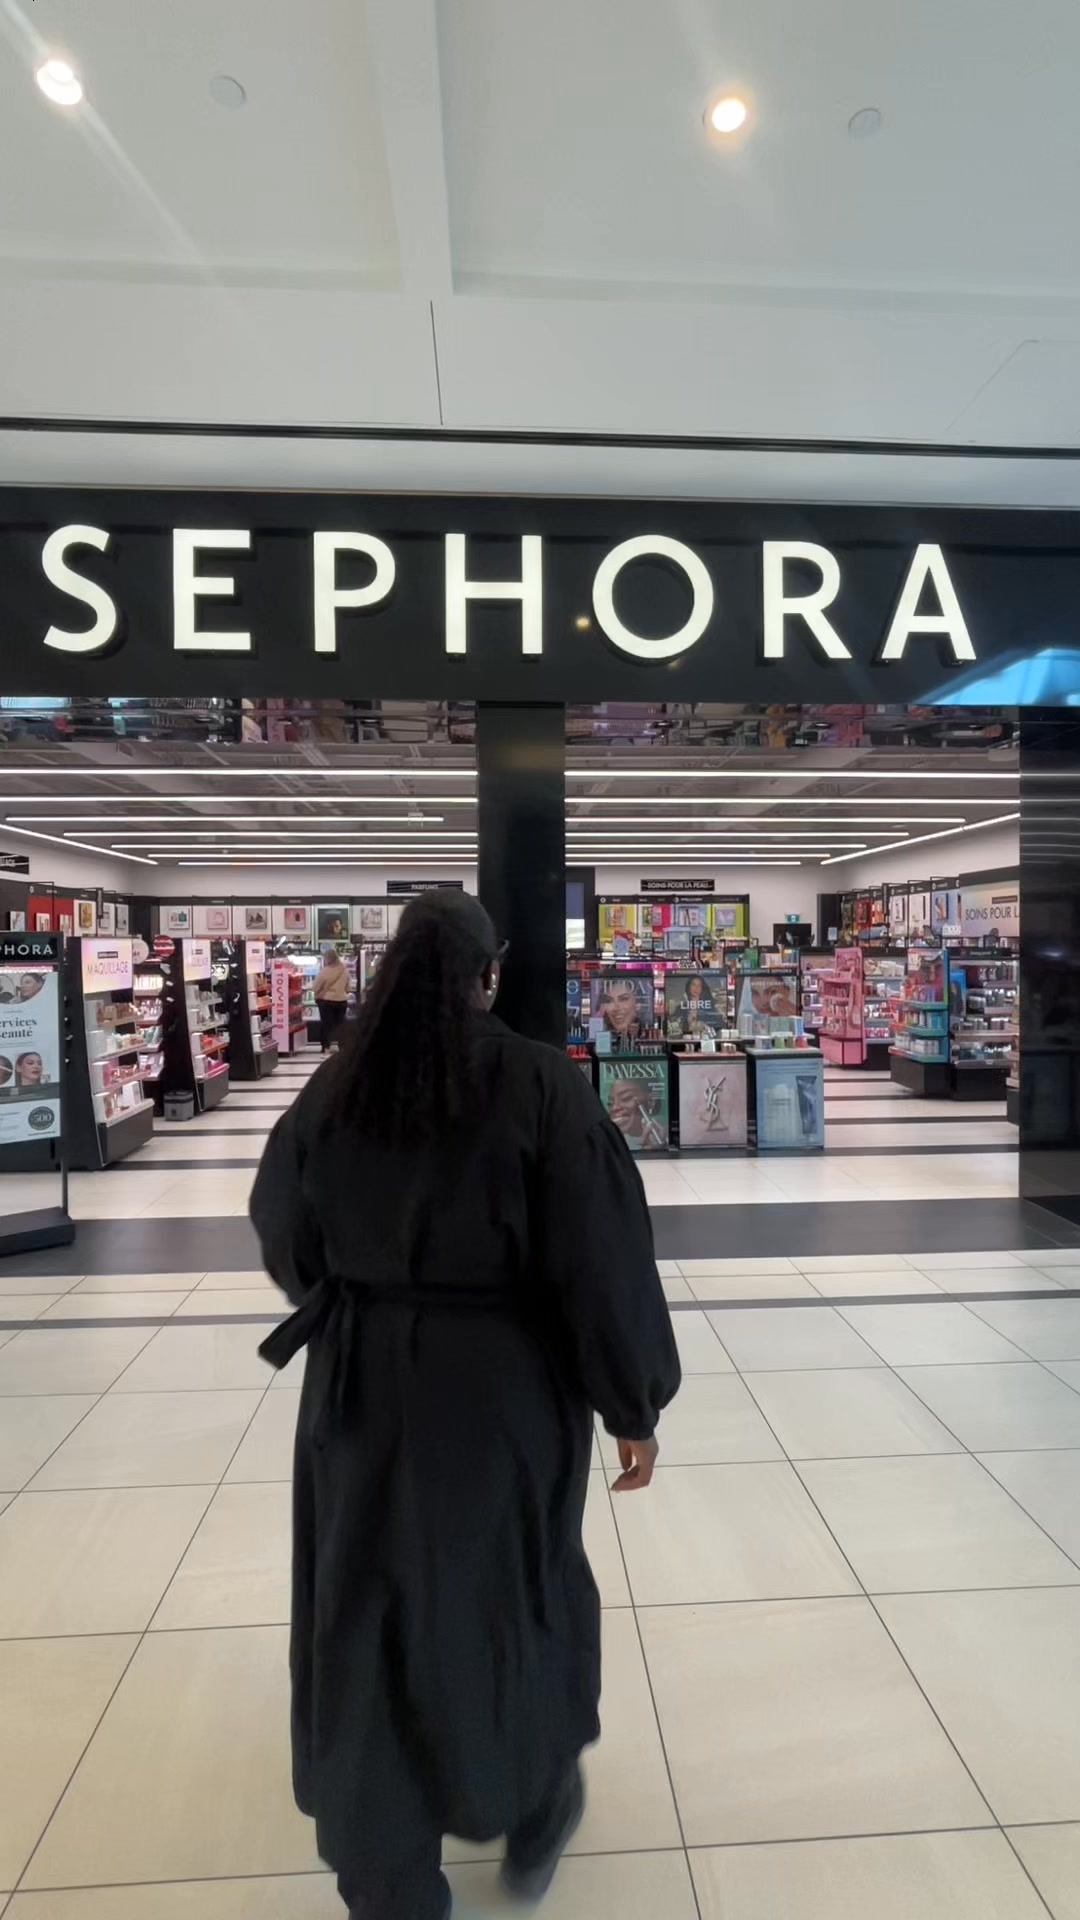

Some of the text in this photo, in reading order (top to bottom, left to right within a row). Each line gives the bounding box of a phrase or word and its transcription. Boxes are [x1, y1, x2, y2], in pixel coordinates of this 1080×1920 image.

[42, 524, 977, 660] SEPHORA
[965, 907, 988, 920] SOINS
[990, 906, 1011, 919] POUR
[0, 944, 53, 955] HORA
[87, 961, 129, 976] MAQUILLAGE
[680, 1000, 712, 1010] LIBRE
[0, 1026, 33, 1039] eauté
